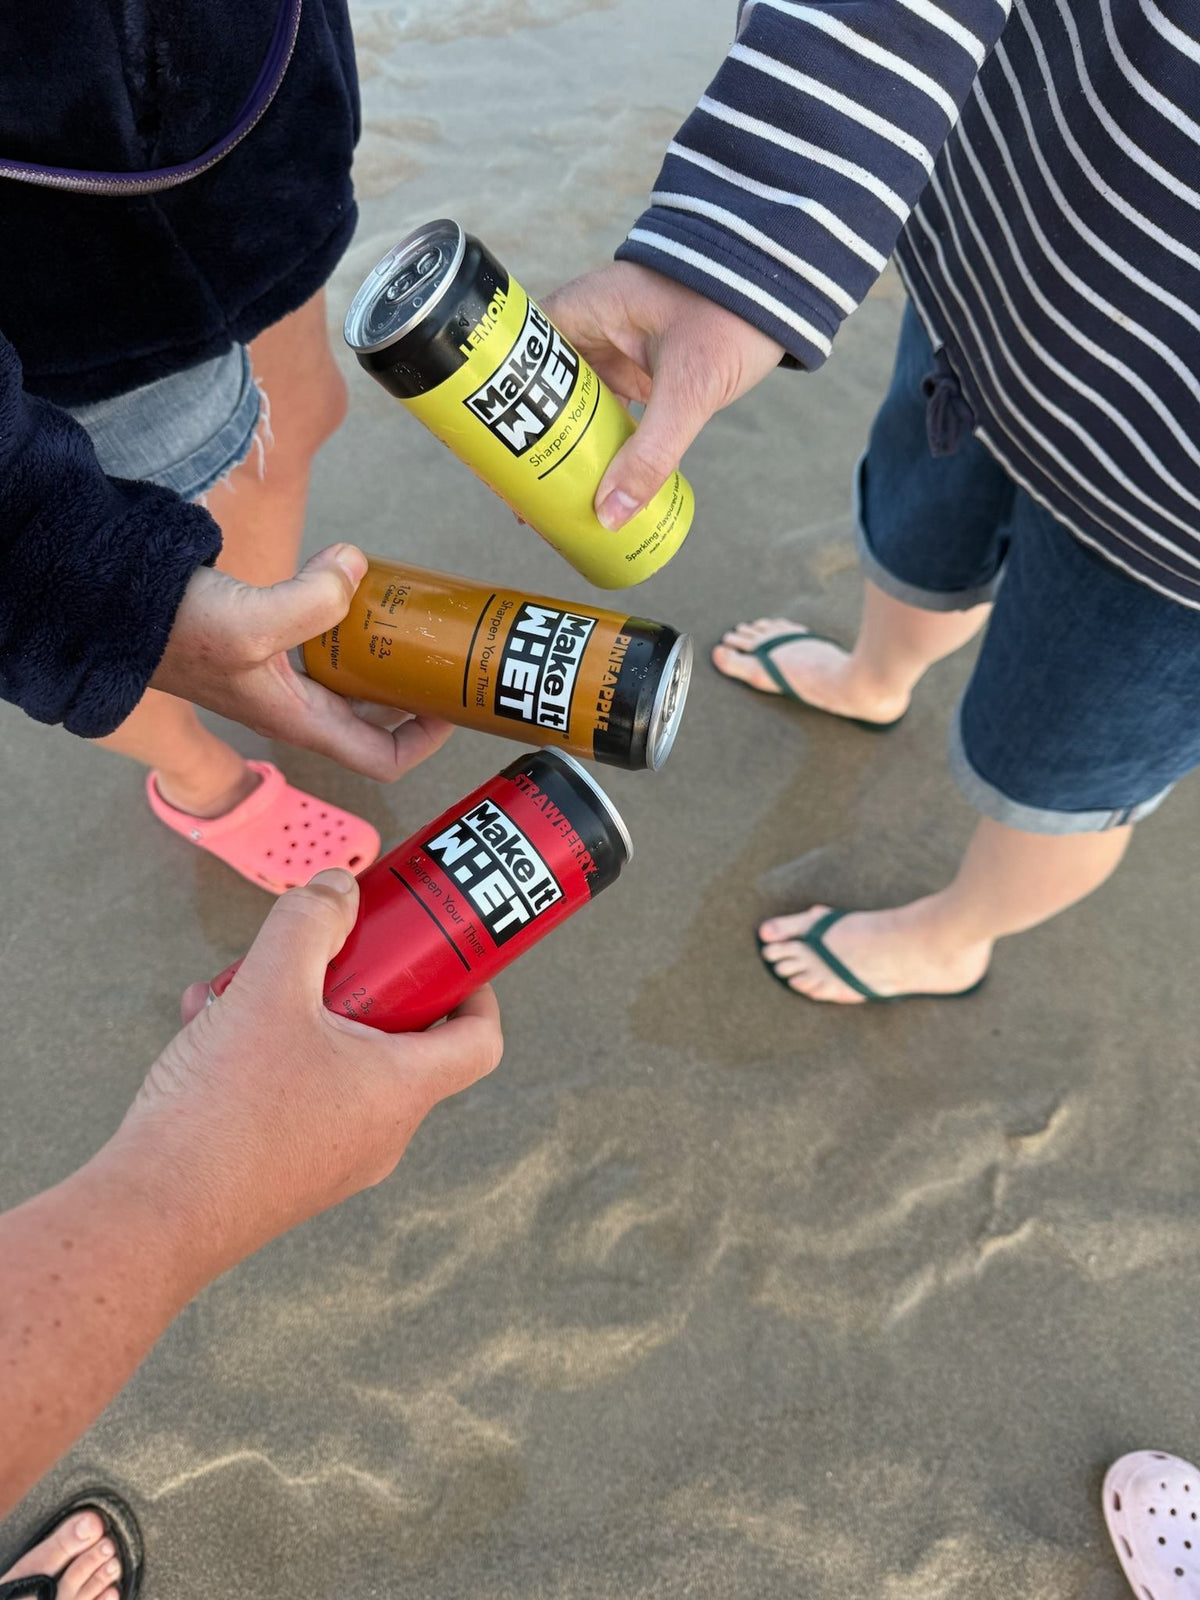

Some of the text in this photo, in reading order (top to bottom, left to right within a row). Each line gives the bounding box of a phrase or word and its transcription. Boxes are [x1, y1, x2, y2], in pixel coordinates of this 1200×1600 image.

[459, 286, 509, 359] LEMON
[471, 306, 549, 420] Make It
[495, 330, 577, 451] WHET
[529, 425, 572, 467] Sharpen
[568, 397, 587, 423] Your
[625, 531, 659, 562] Sparkling
[656, 491, 678, 532] Flavoured
[368, 634, 379, 655] Sugar
[381, 584, 396, 607] Calories
[330, 645, 340, 670] Water
[475, 600, 514, 707] Sharpen Your Thirst
[500, 605, 560, 720] WHET
[539, 615, 592, 727] Make It
[594, 633, 632, 732] PINEAPPLE
[465, 802, 558, 911] Make It
[513, 774, 598, 877] STRAWBERRY
[407, 855, 486, 958] Sharpen Your Thirst
[428, 824, 531, 934] WHET
